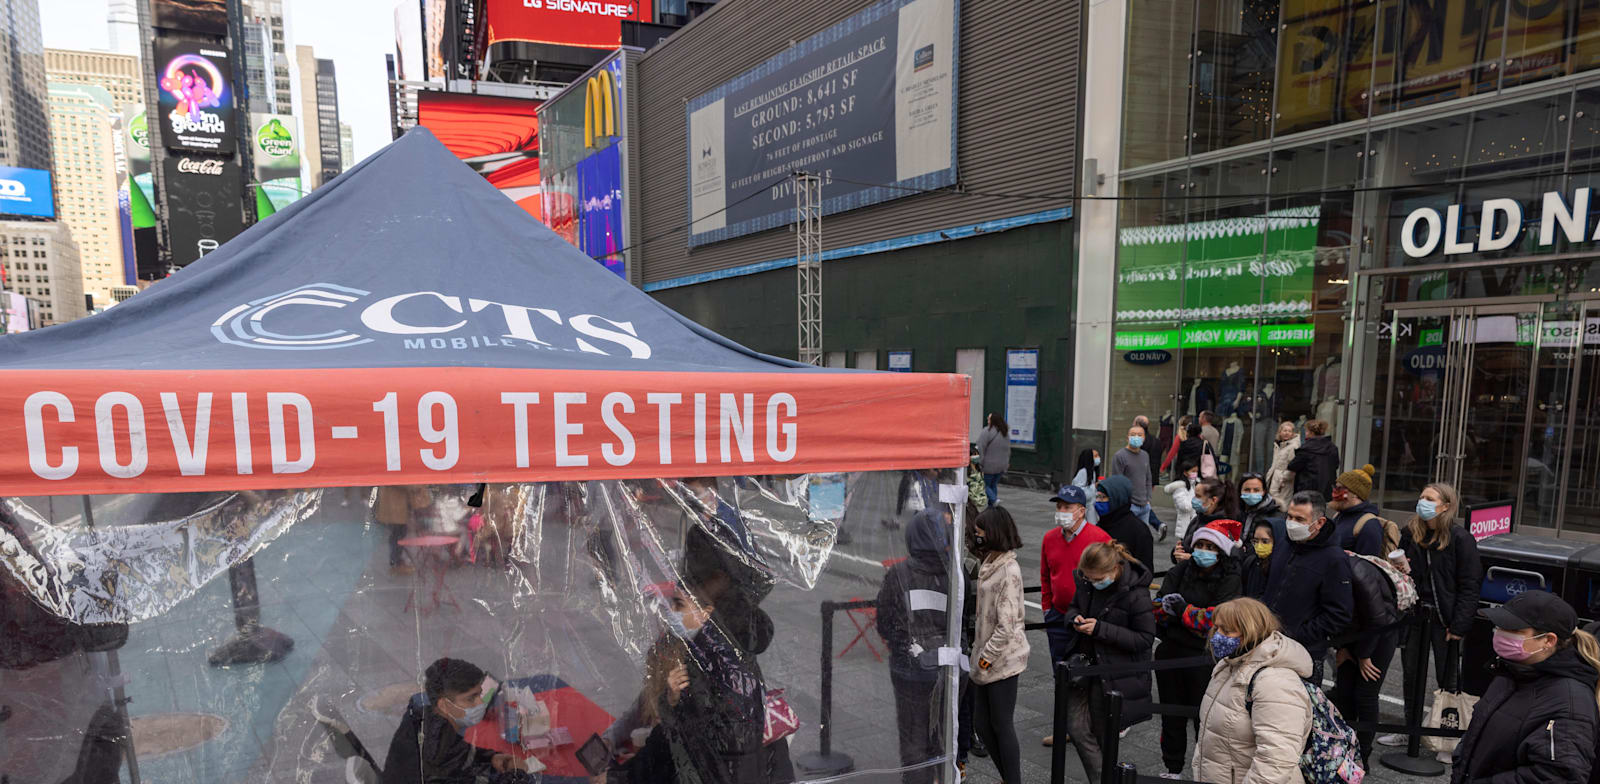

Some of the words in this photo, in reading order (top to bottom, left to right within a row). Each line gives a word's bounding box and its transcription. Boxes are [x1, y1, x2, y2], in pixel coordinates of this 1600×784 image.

[523, 0, 542, 8] LG
[546, 0, 628, 17] SIGNATURE
[734, 103, 750, 116] LAST
[750, 82, 787, 109] REMAINING
[789, 66, 825, 91] FLAGSHIP
[826, 51, 855, 73] RETAIL
[858, 36, 886, 57] SPACE
[751, 96, 802, 128] GROUND:
[807, 79, 836, 105] 8,641
[842, 69, 858, 90] SF
[752, 119, 801, 150] SECOND:
[806, 103, 835, 129] 5,793
[840, 95, 856, 116] SF
[261, 137, 292, 147] Green
[265, 145, 293, 156] Giant
[775, 145, 790, 159] FEET
[792, 142, 801, 153] OF
[802, 128, 838, 150] FRONTAGE
[738, 175, 752, 188] FEET
[753, 172, 761, 183] OF
[762, 149, 830, 180] HEIGHT-STOREFRONT
[832, 142, 846, 156] AND
[848, 130, 884, 151] SIGNAGE
[772, 169, 833, 201] DIVIE
[1401, 198, 1523, 258] OLD
[403, 336, 517, 350] MOBILE
[1130, 353, 1146, 361] OLD
[1146, 352, 1167, 361] NAVY
[1411, 354, 1434, 369] OLD
[23, 391, 460, 480] COVID-19
[501, 391, 798, 468] TESTING
[1470, 516, 1511, 536] COVID-19
